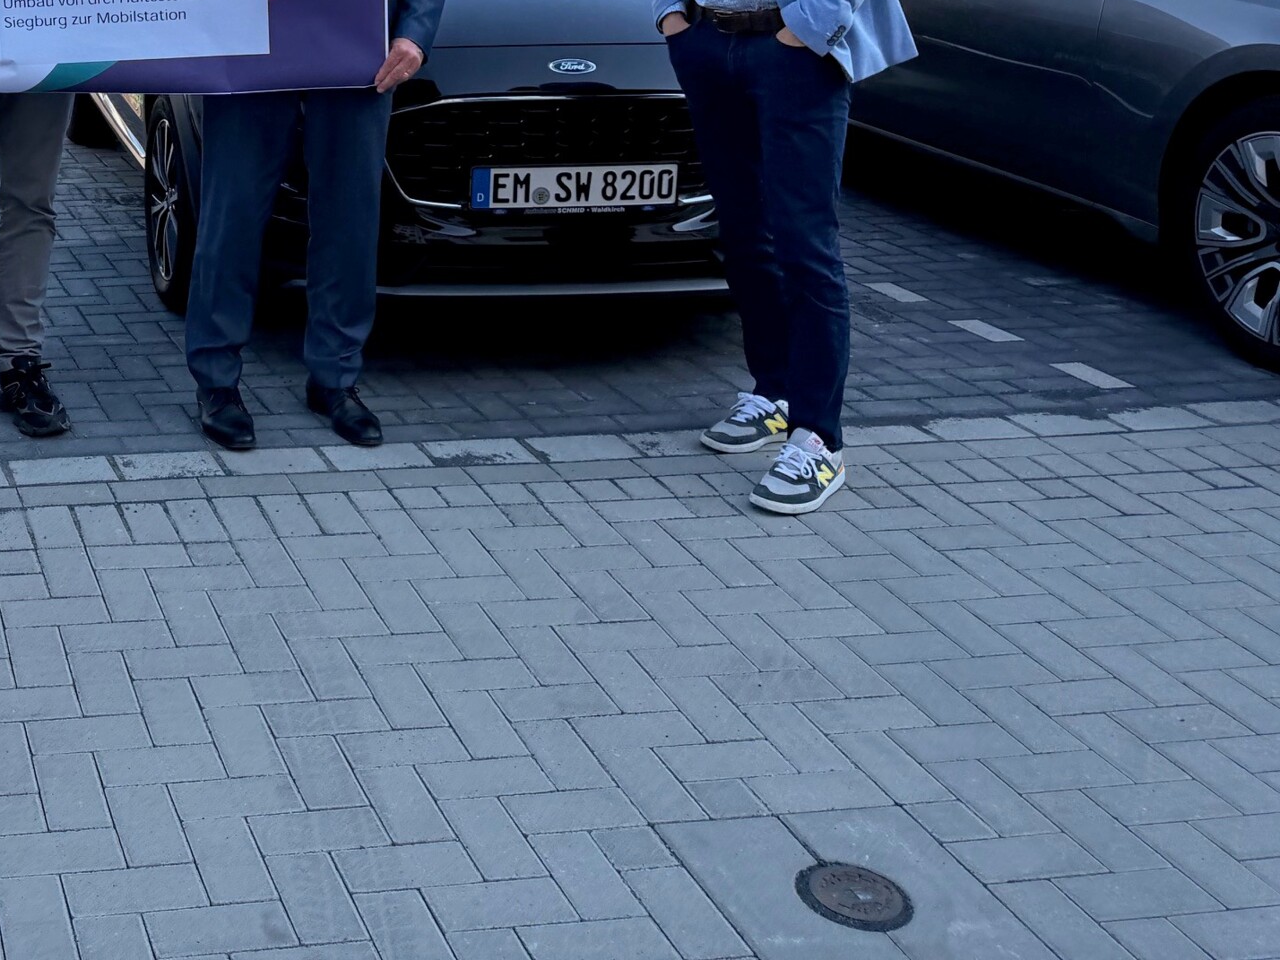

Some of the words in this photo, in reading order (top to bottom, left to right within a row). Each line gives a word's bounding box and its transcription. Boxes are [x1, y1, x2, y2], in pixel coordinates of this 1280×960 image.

[4, 14, 68, 31] Siegburg
[71, 14, 93, 25] zur
[97, 9, 187, 24] Mobilstation
[560, 62, 585, 71] Ford
[477, 193, 484, 202] D
[492, 173, 531, 204] EM
[554, 171, 592, 202] SW
[601, 169, 673, 201] 8200
